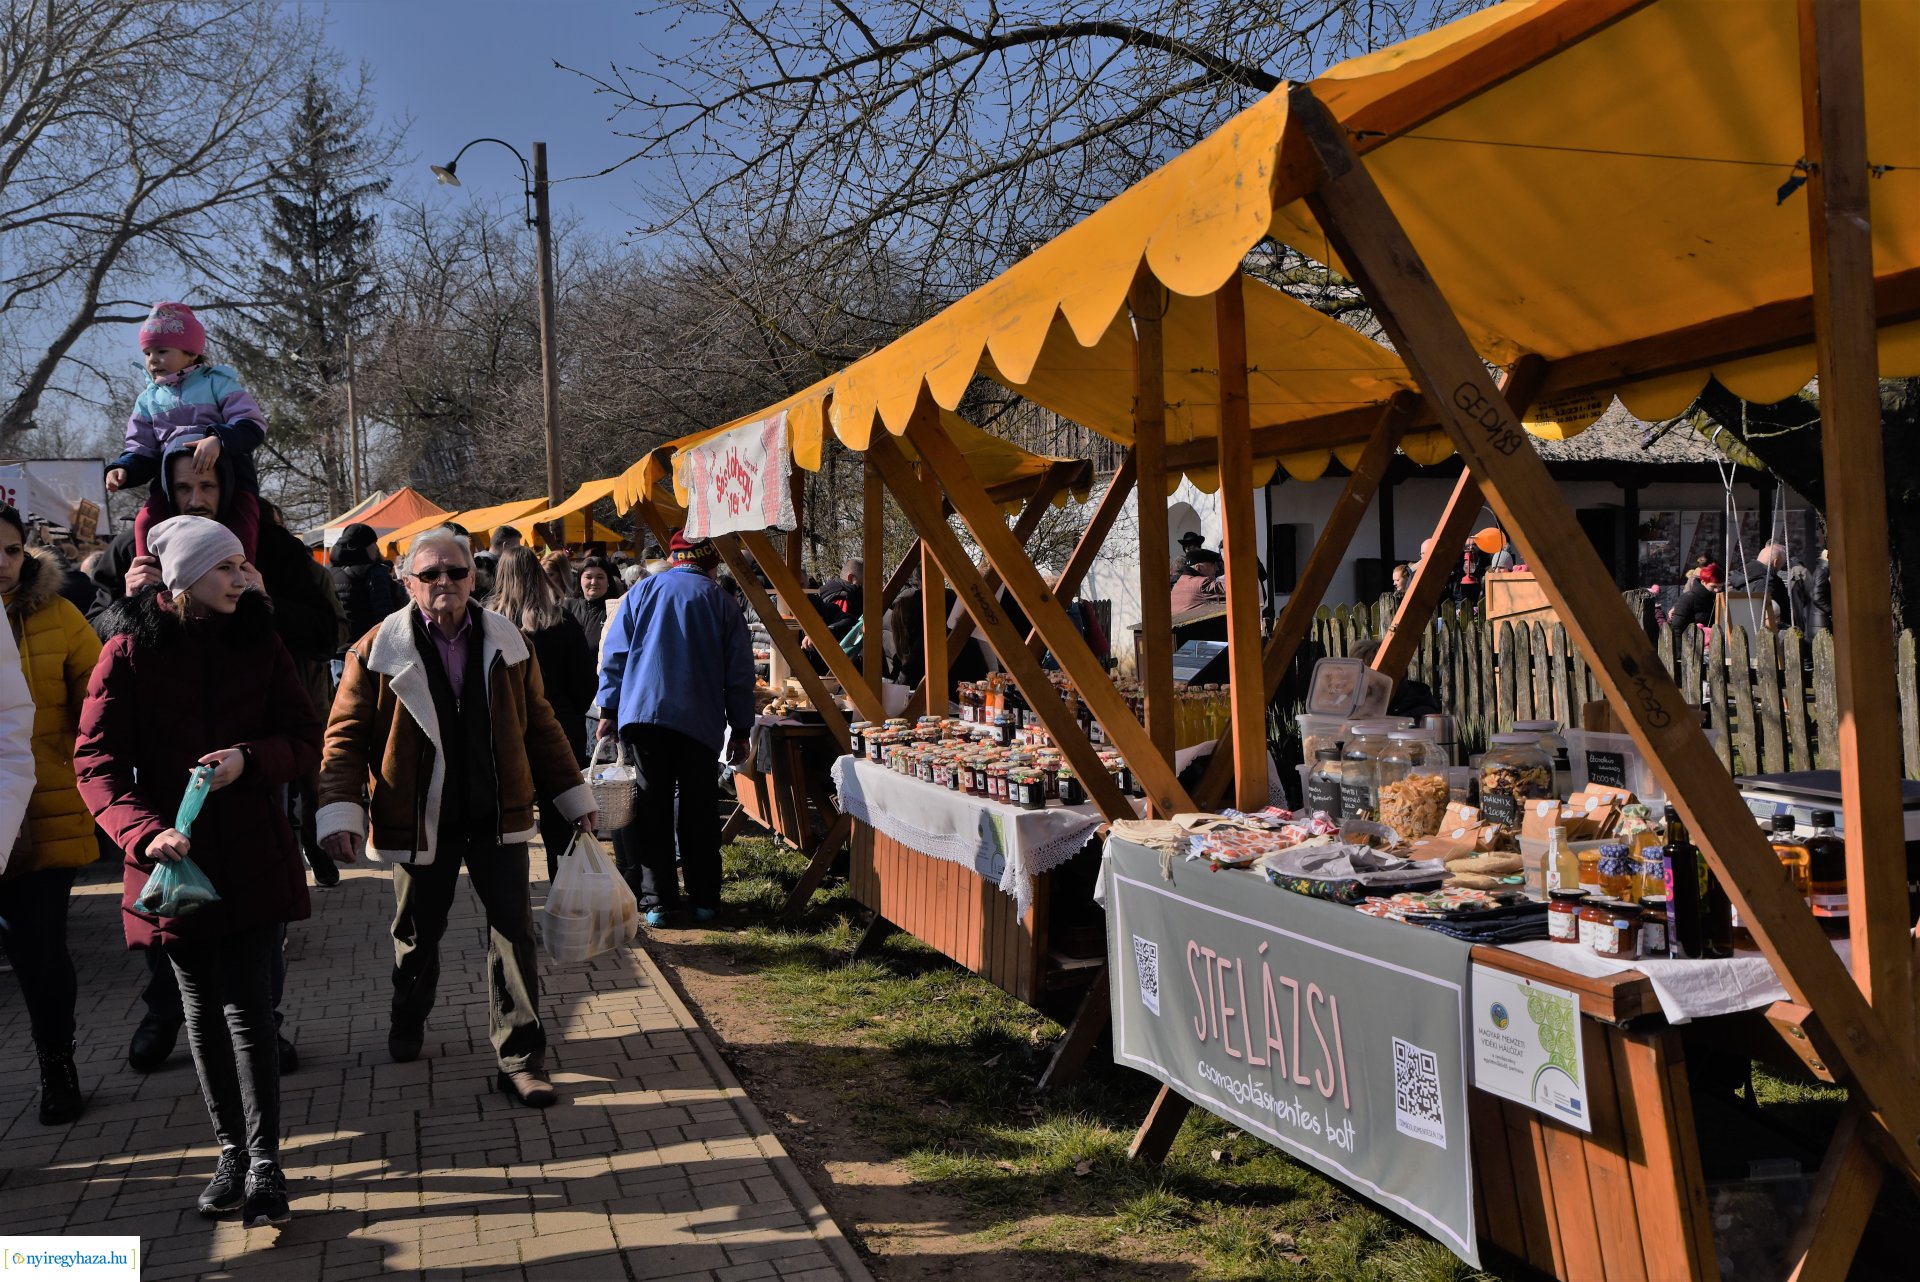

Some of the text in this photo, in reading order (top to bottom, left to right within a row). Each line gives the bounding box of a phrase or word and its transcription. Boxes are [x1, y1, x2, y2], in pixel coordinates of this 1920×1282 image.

[1187, 940, 1350, 1110] STELÁZSI
[1198, 1060, 1356, 1153] csomagolásmentes bolt
